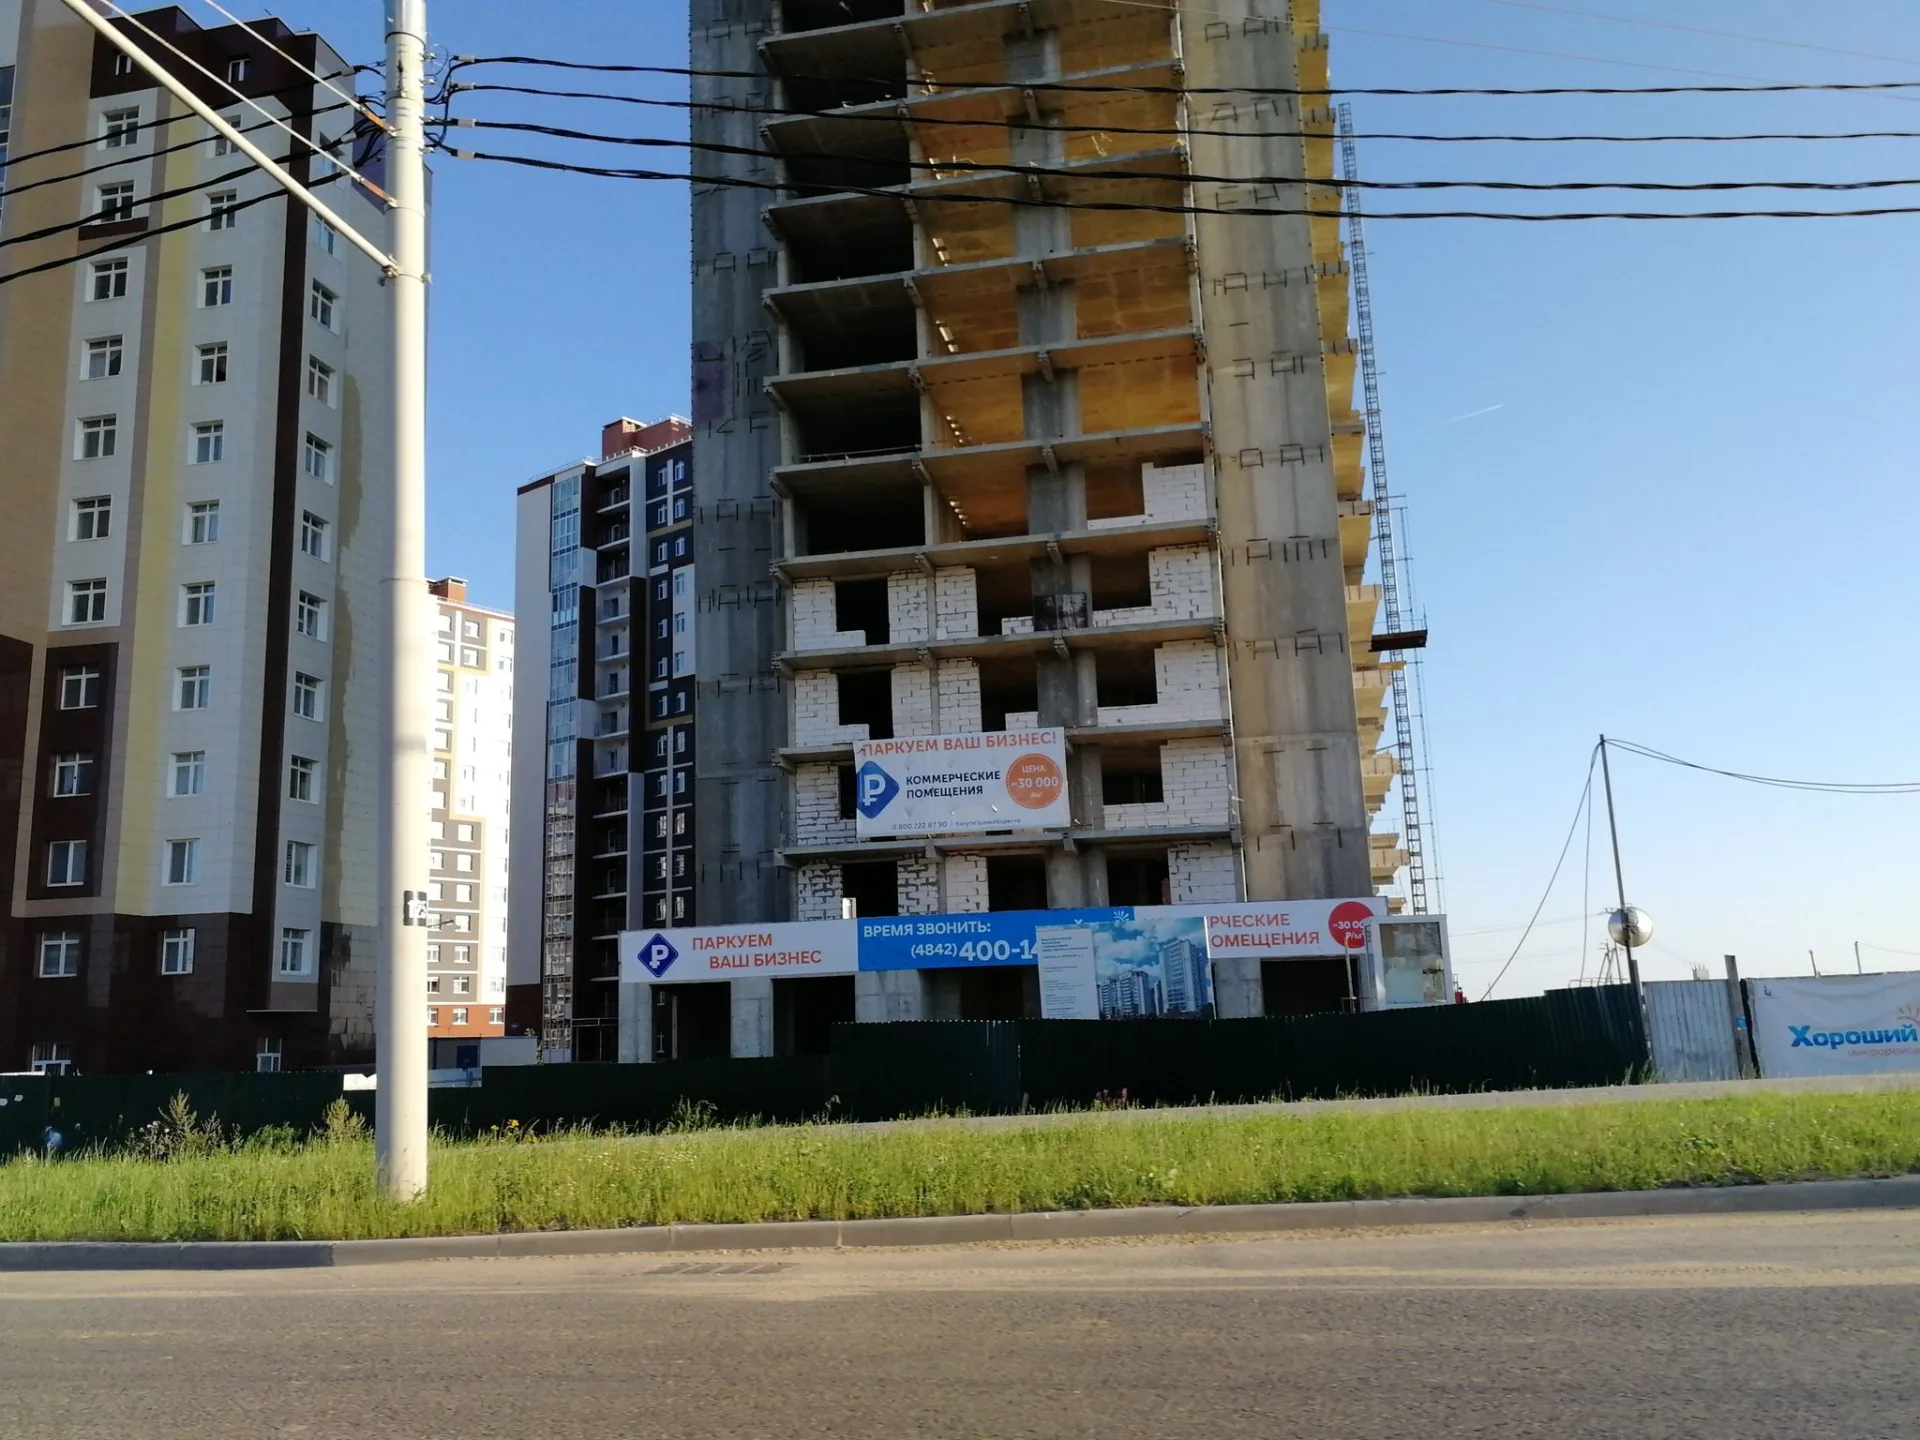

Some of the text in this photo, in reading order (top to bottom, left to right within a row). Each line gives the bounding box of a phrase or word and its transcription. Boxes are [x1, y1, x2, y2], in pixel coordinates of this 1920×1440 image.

[863, 731, 1057, 757] ПАРКУЕМ ВАШ БИЗНЕС!
[1021, 764, 1046, 774] ЦЕНА
[906, 770, 1001, 786] КОММЕРЧЕСКИЕ
[1017, 778, 1033, 789] 30
[1035, 776, 1059, 788] 000
[906, 785, 984, 800] ПОМЕЩЕНИЯ
[863, 920, 991, 938] ВРЕМЯ ЗВОНИТЬ:
[1206, 914, 1291, 929] РЧЕСКИЕ
[1337, 920, 1351, 930] 30
[692, 932, 773, 951] ПАРКУЕМ
[910, 943, 957, 959] (4842)
[708, 949, 822, 970] ВАШ БИЗНЕС
[1788, 1024, 1918, 1050] Хороший
